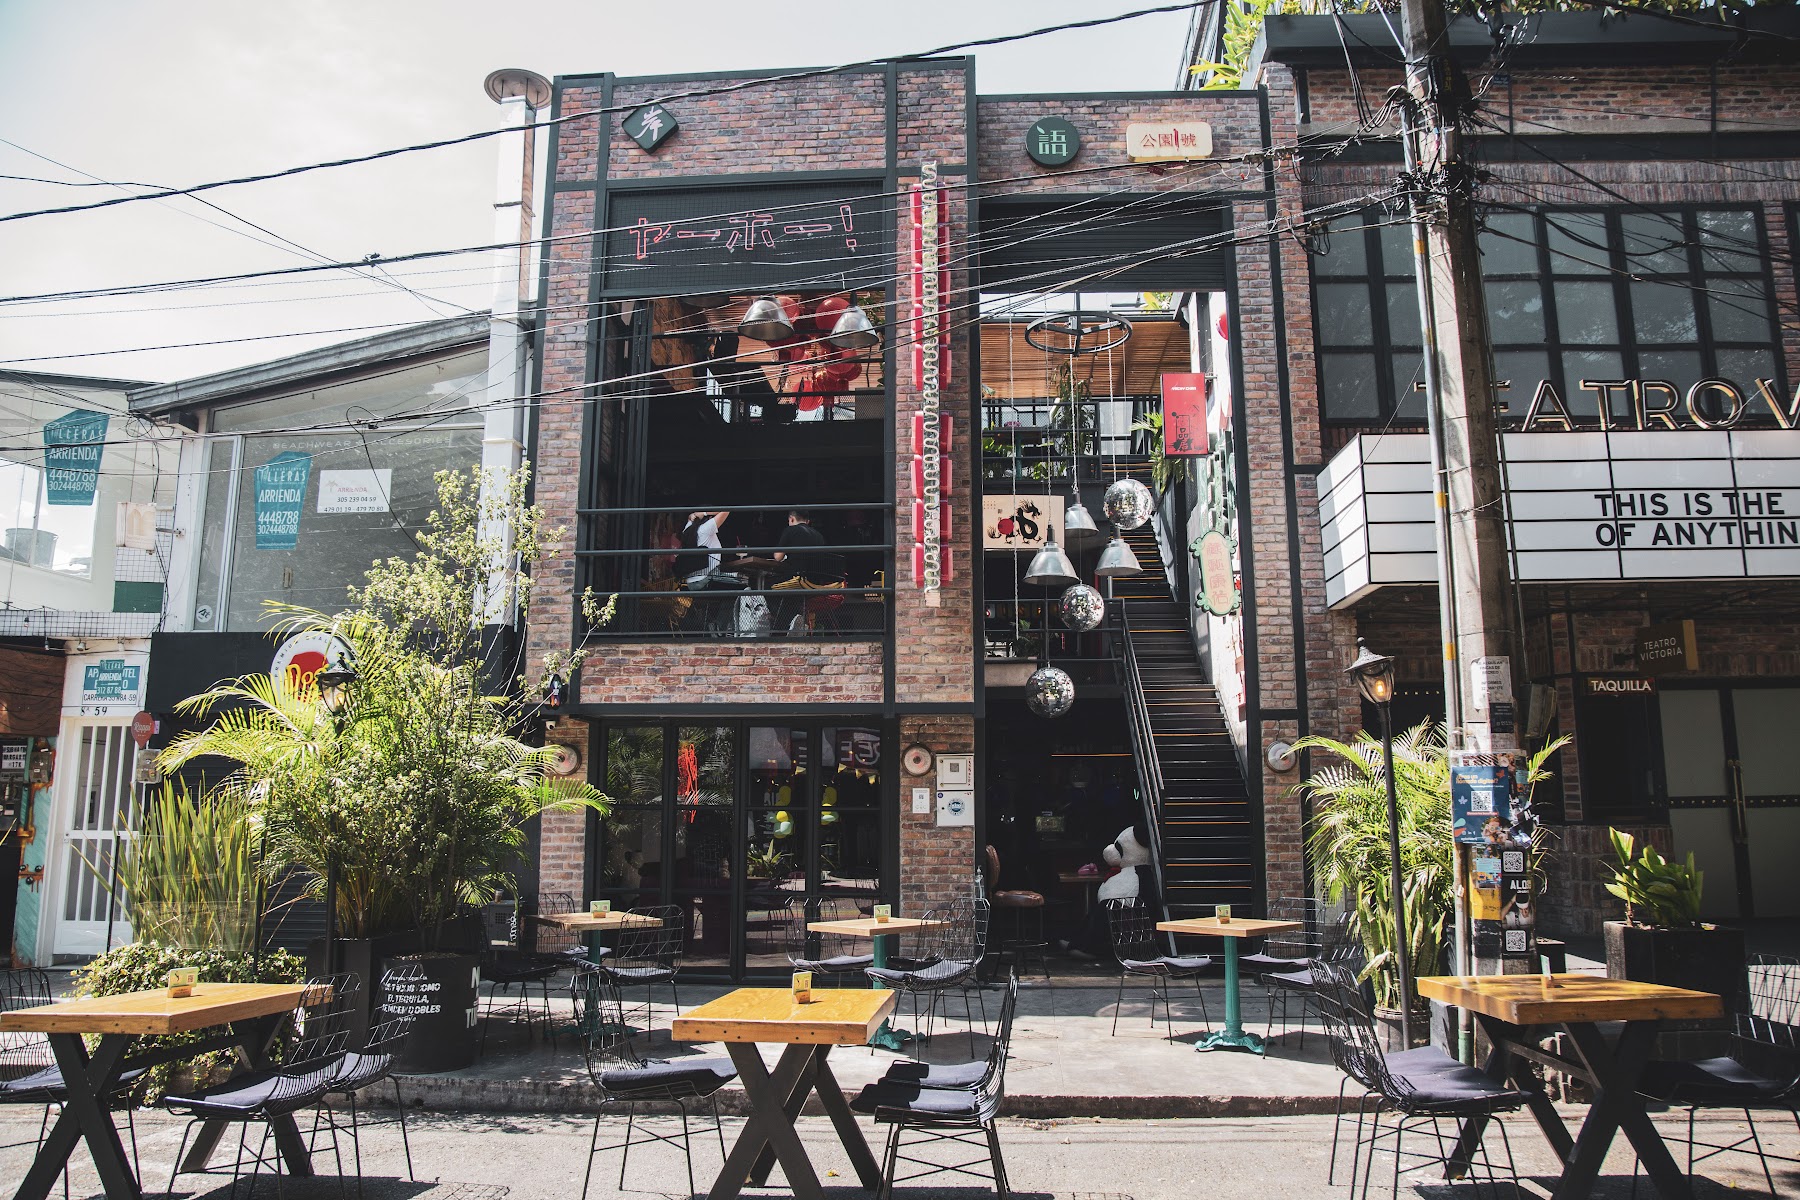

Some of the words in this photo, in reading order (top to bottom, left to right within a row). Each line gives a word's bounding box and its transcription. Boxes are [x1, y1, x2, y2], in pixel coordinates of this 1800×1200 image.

[1036, 125, 1069, 157] 語
[273, 440, 351, 449] BEACHWEAR
[49, 446, 98, 461] ARRIENDA
[49, 468, 96, 482] 4448788
[267, 470, 306, 482] LLERAS
[48, 481, 95, 492] 3024448788
[258, 488, 301, 503] ARRIENDA
[1594, 492, 1669, 516] THIS
[1683, 492, 1713, 516] IS
[1722, 492, 1785, 515] THE
[257, 510, 300, 525] 4448788
[257, 524, 298, 535] 3024448788
[1595, 522, 1636, 547] OF
[1651, 521, 1799, 546] ANYTHIN
[1643, 637, 1677, 650] TEATRO
[1640, 647, 1683, 661] VICTORIA
[99, 672, 122, 681] ARRIENDA
[1591, 680, 1651, 692] TAQUILLA
[94, 706, 108, 716] 59
[133, 721, 152, 734] Rappi
